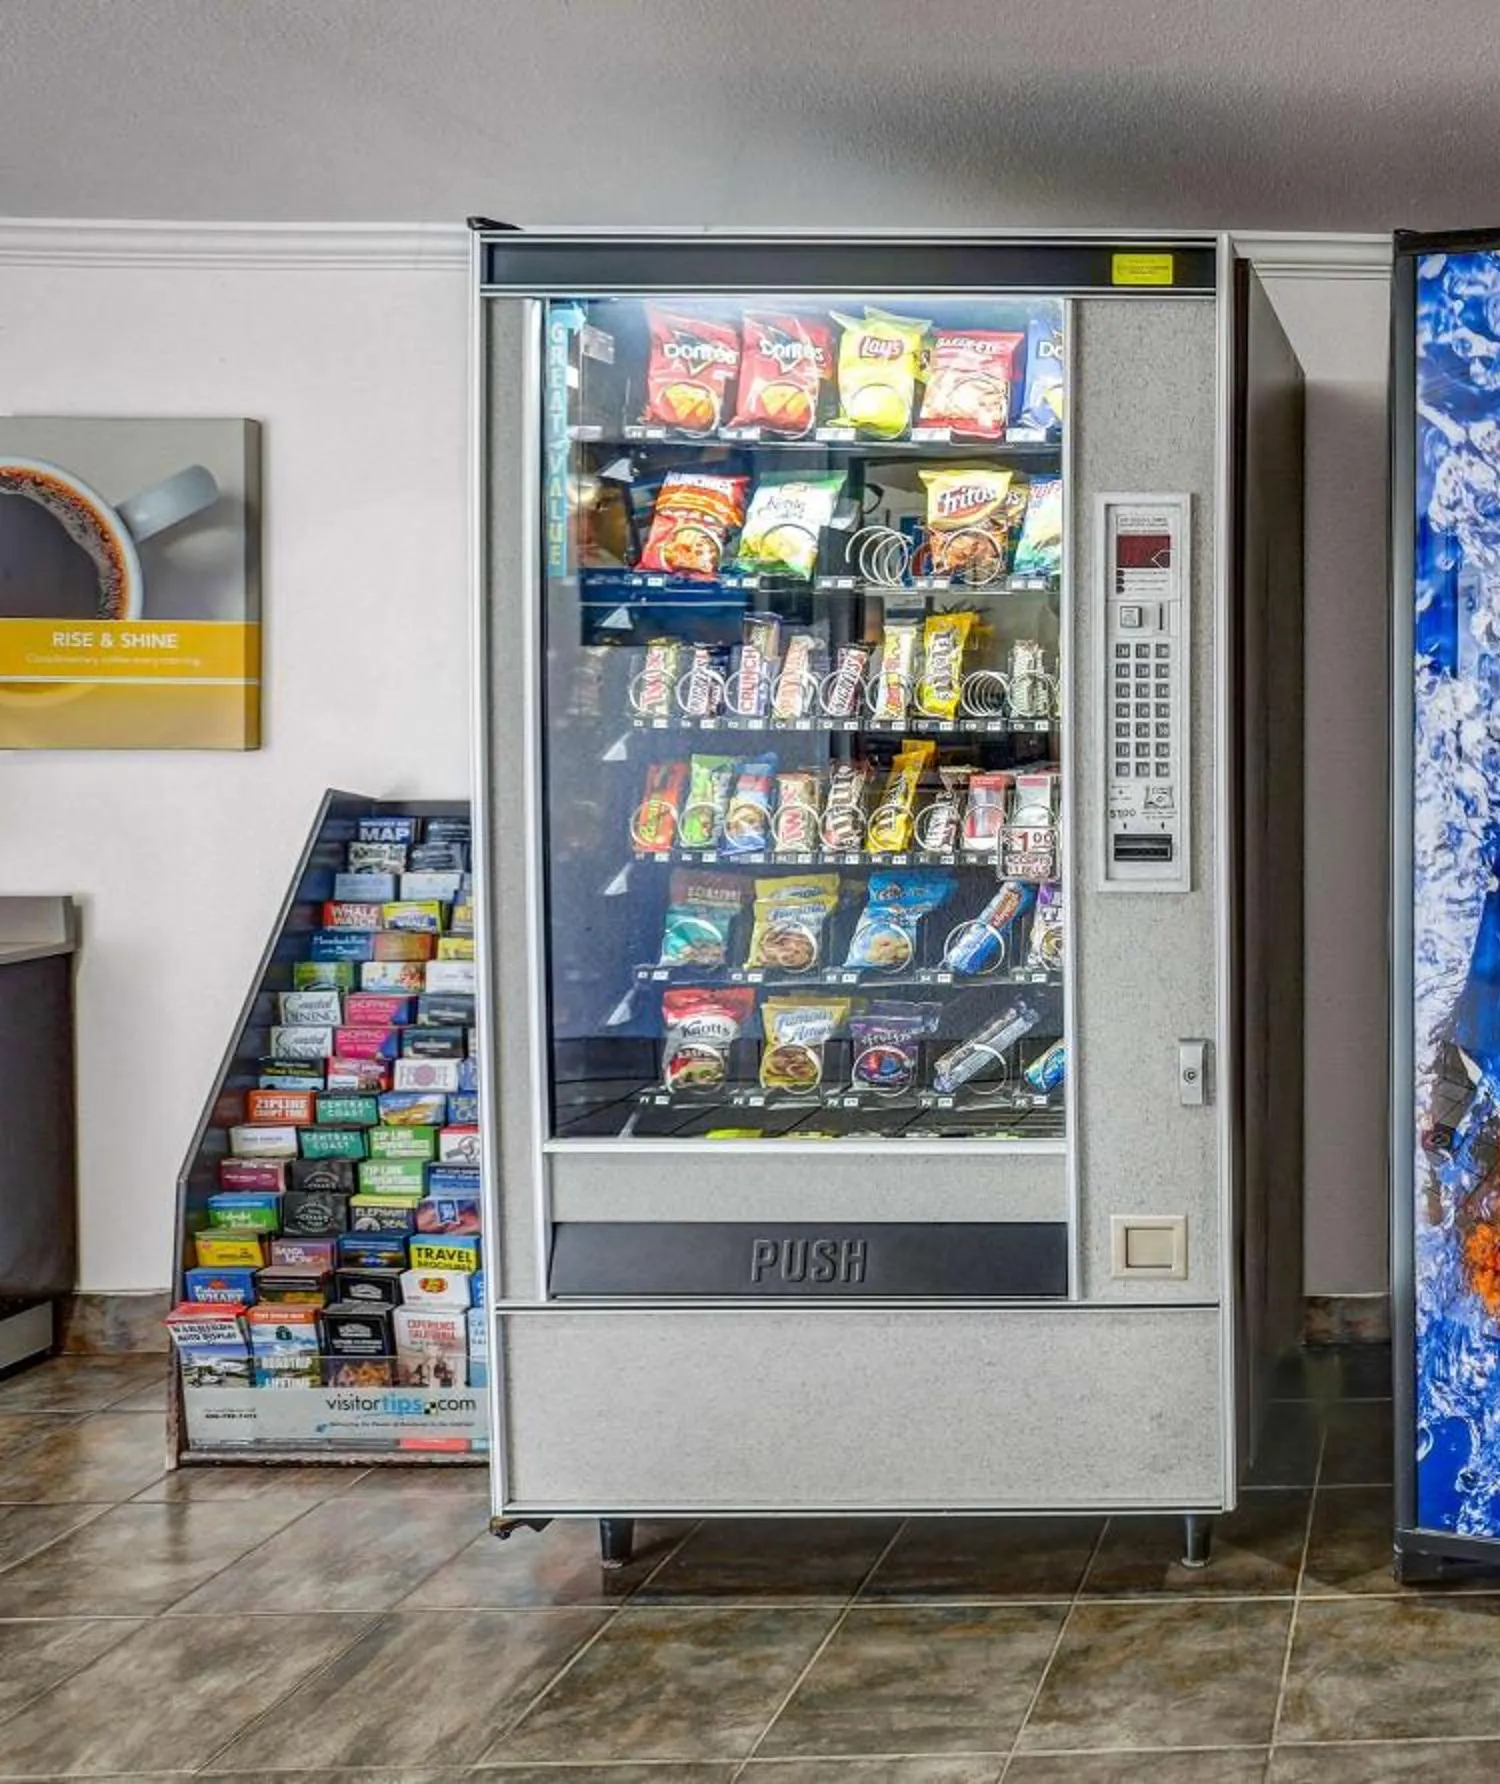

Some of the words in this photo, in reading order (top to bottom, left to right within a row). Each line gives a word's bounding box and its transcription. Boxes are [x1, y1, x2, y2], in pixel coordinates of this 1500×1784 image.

[549, 452, 564, 566] VALUE
[53, 631, 93, 647] RISE
[100, 632, 113, 648] &
[120, 632, 178, 649] SHINE
[741, 647, 757, 712] CRUNCH
[360, 827, 410, 841] MAP
[415, 1247, 473, 1263] TRAVEL
[751, 1238, 868, 1283] PUSH
